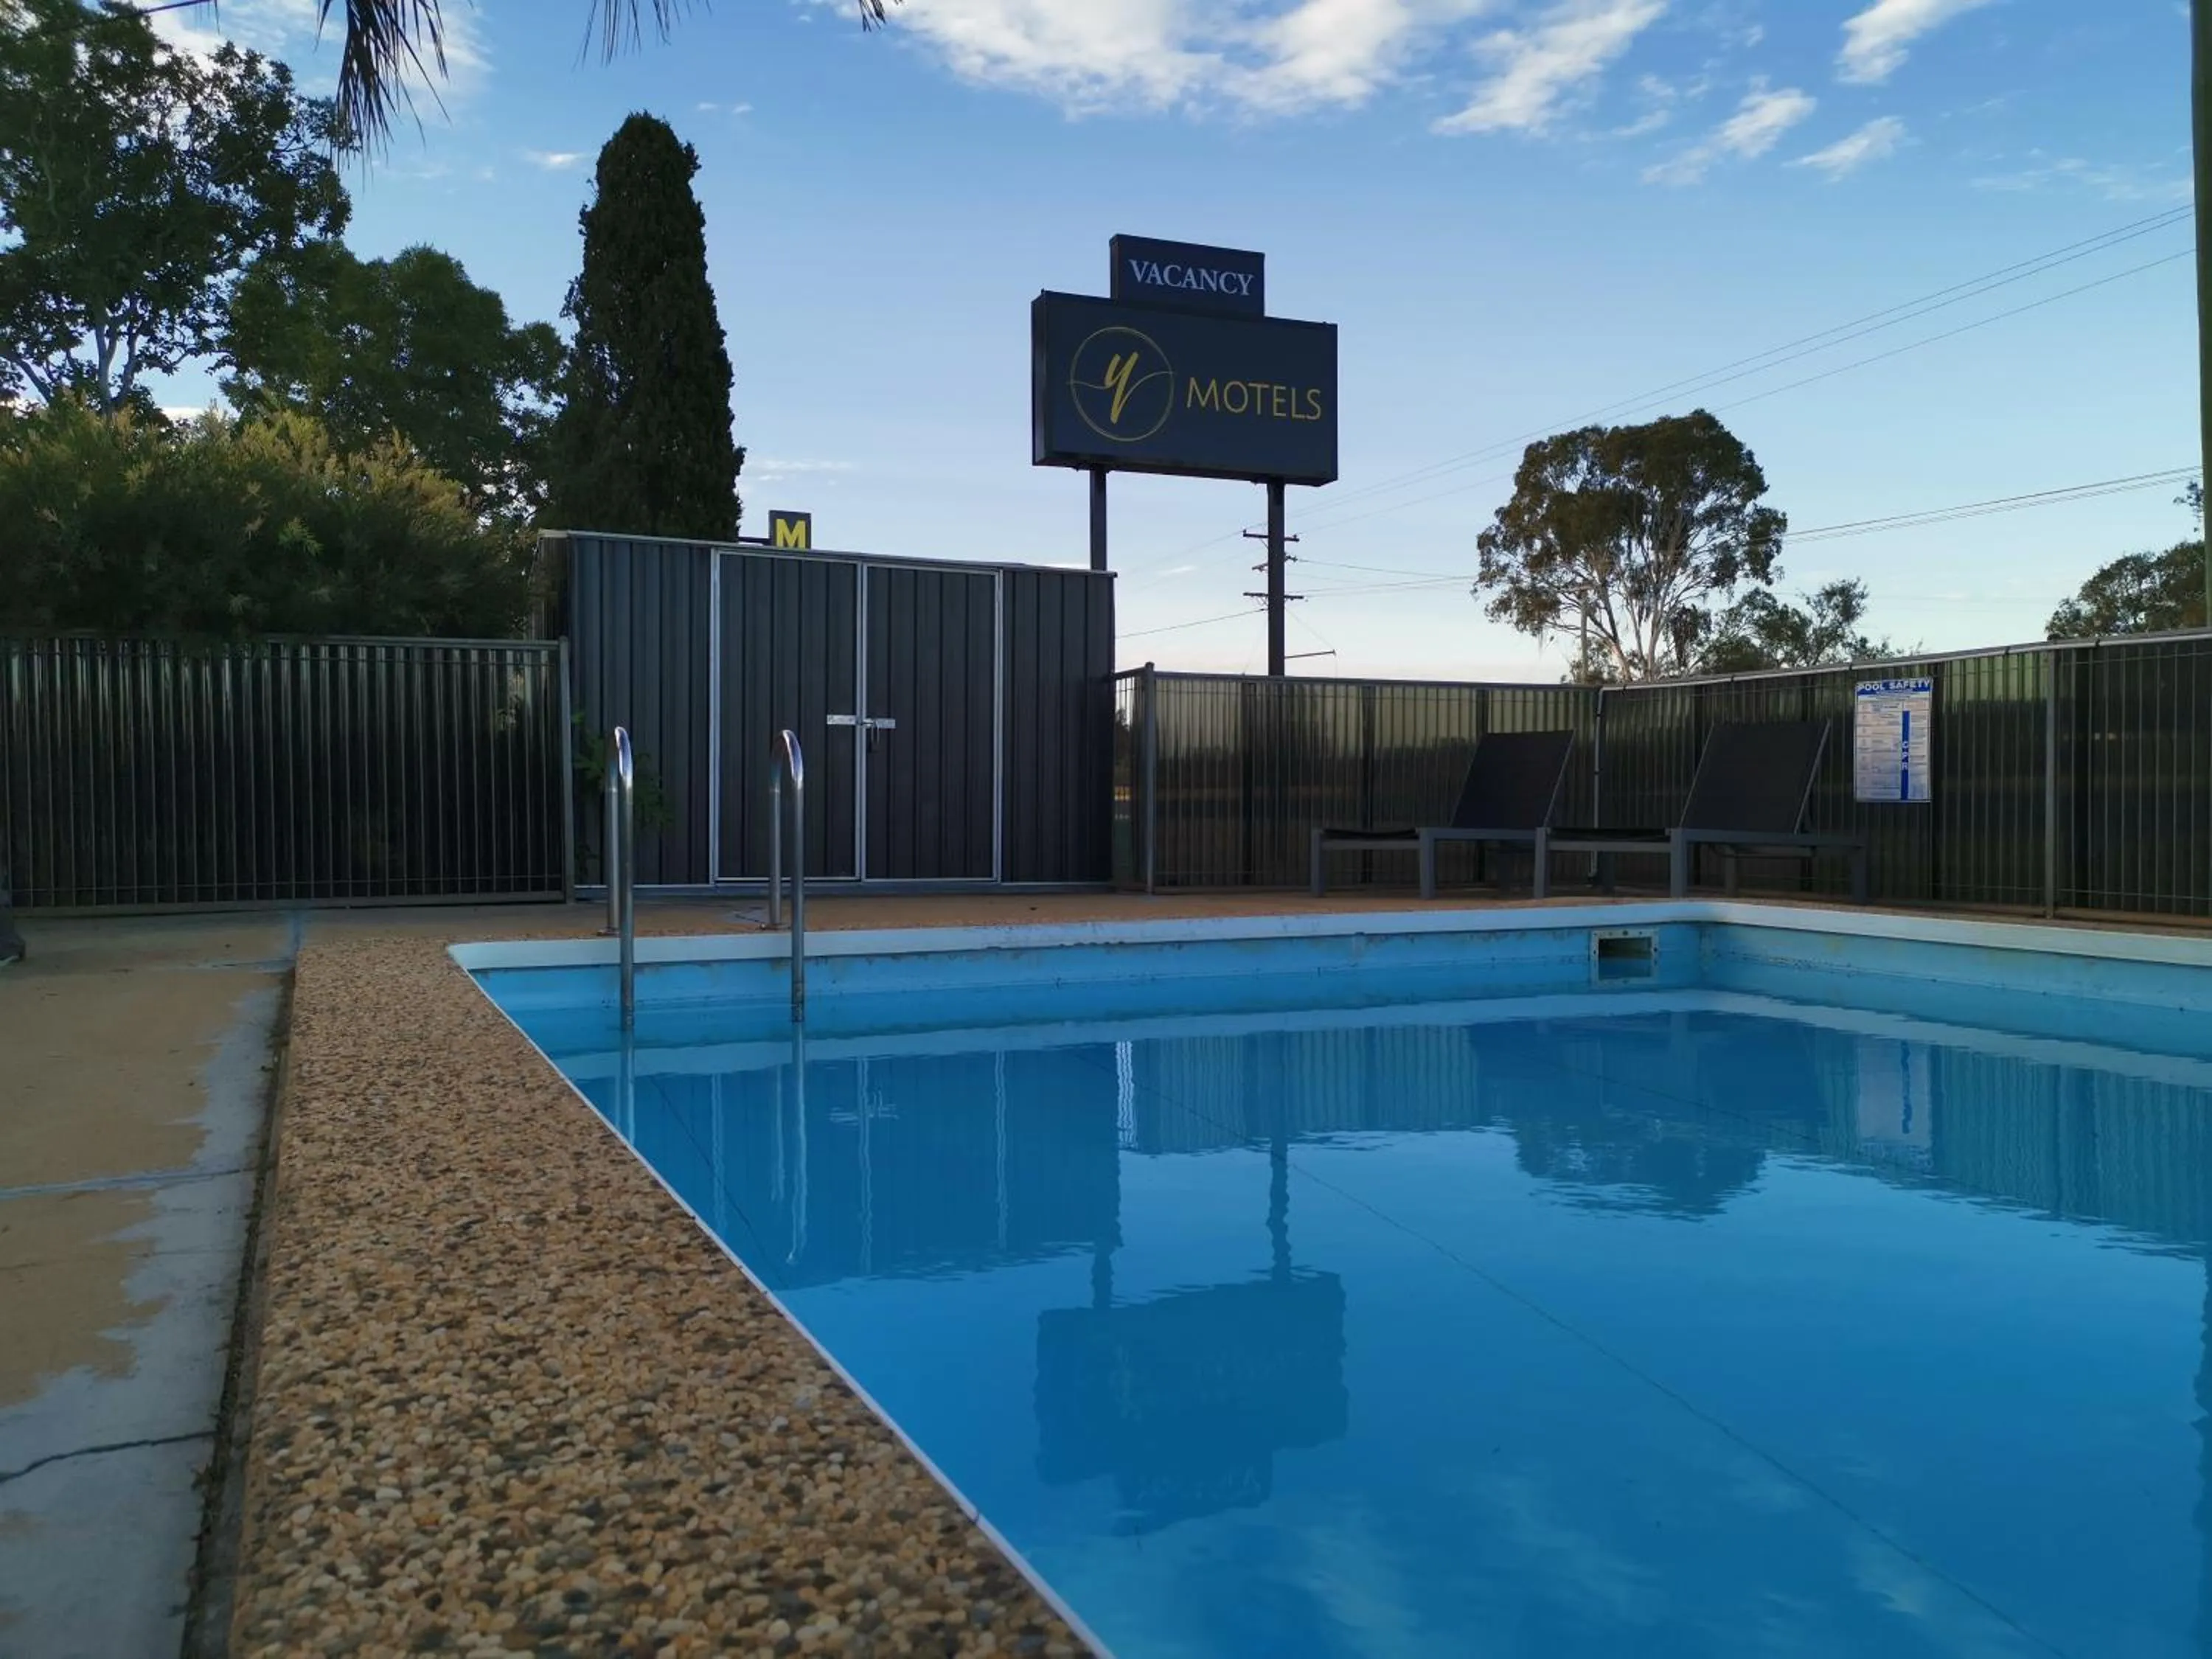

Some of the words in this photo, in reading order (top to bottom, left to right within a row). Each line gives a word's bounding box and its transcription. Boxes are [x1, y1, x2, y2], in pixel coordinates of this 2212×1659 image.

[1129, 259, 1254, 296] VACANCY
[1186, 377, 1322, 420] MOTELS
[776, 518, 806, 548] M
[1856, 682, 1885, 692] POOL
[1890, 680, 1930, 689] SAFETY
